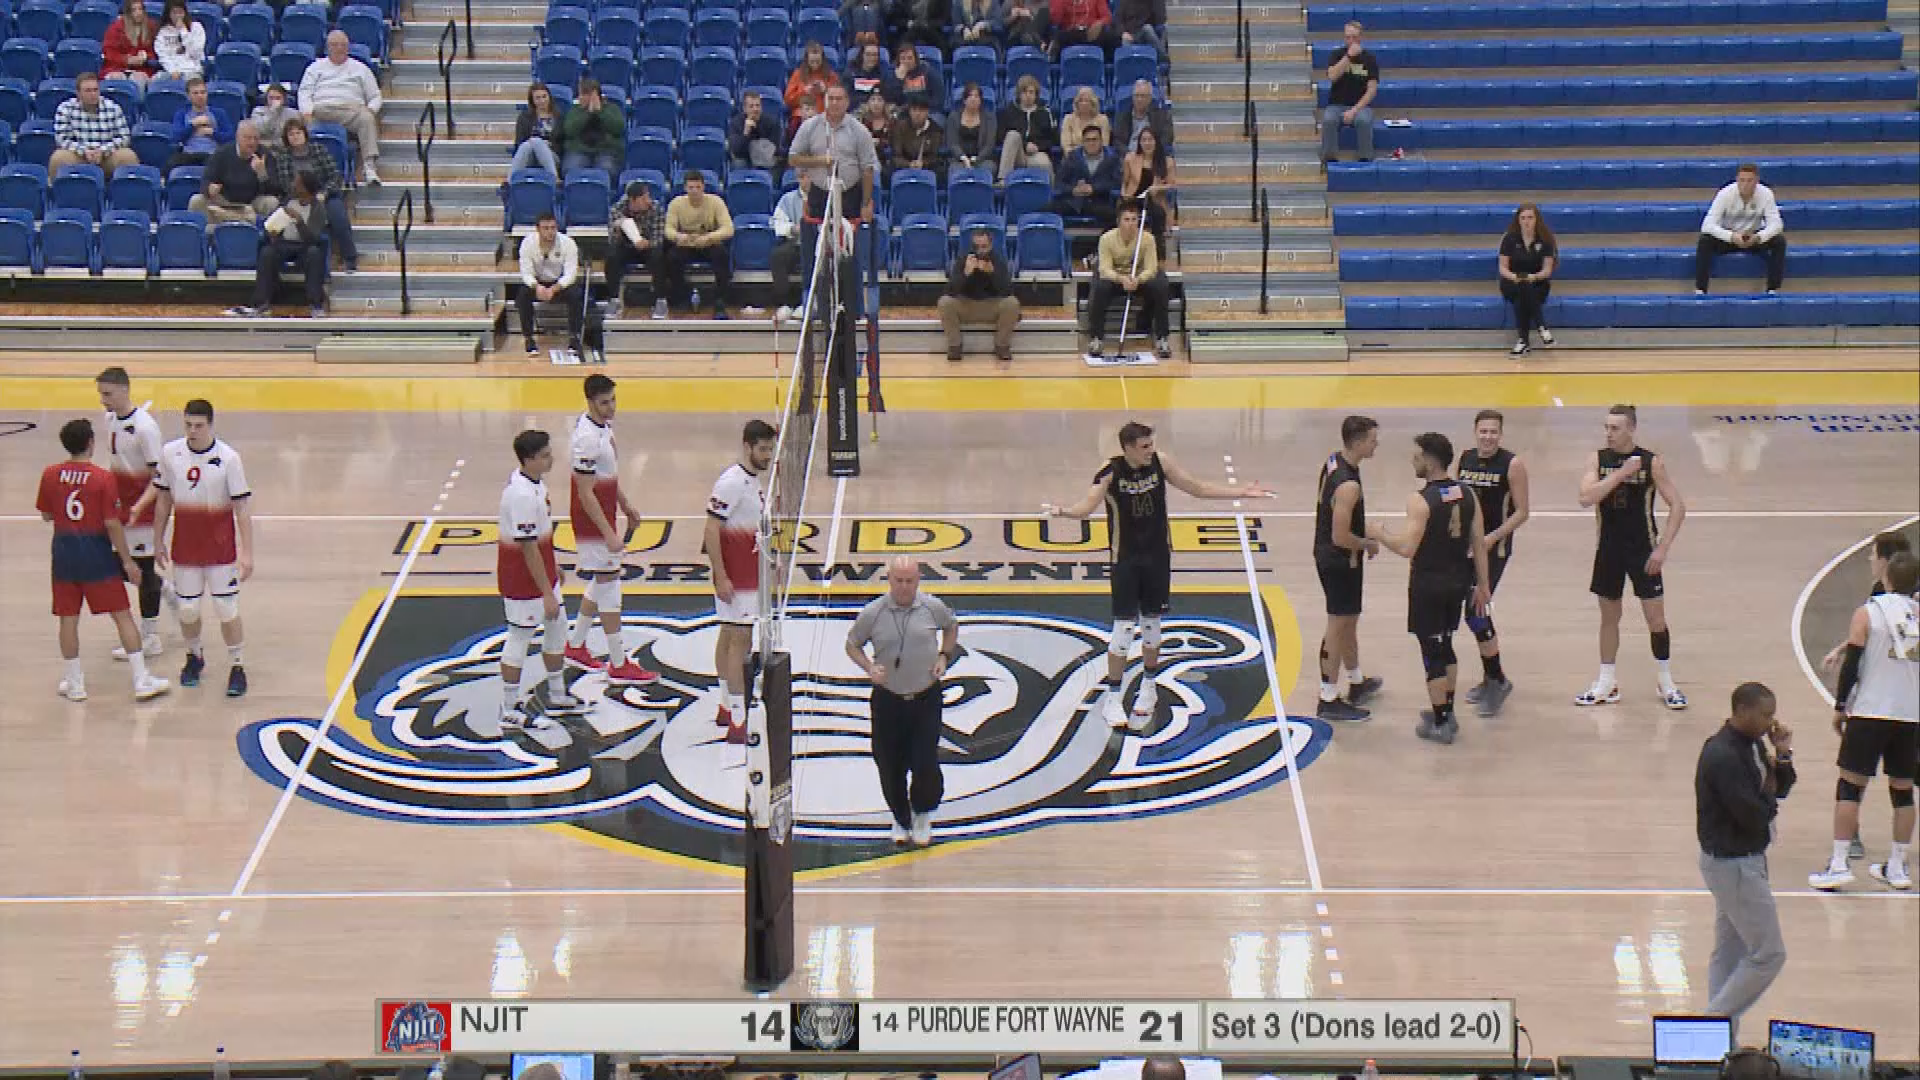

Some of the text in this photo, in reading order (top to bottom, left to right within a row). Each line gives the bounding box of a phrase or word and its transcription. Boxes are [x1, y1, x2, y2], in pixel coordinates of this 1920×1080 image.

[59, 468, 92, 486] NJIT
[187, 466, 201, 491] 9
[65, 489, 85, 521] 6
